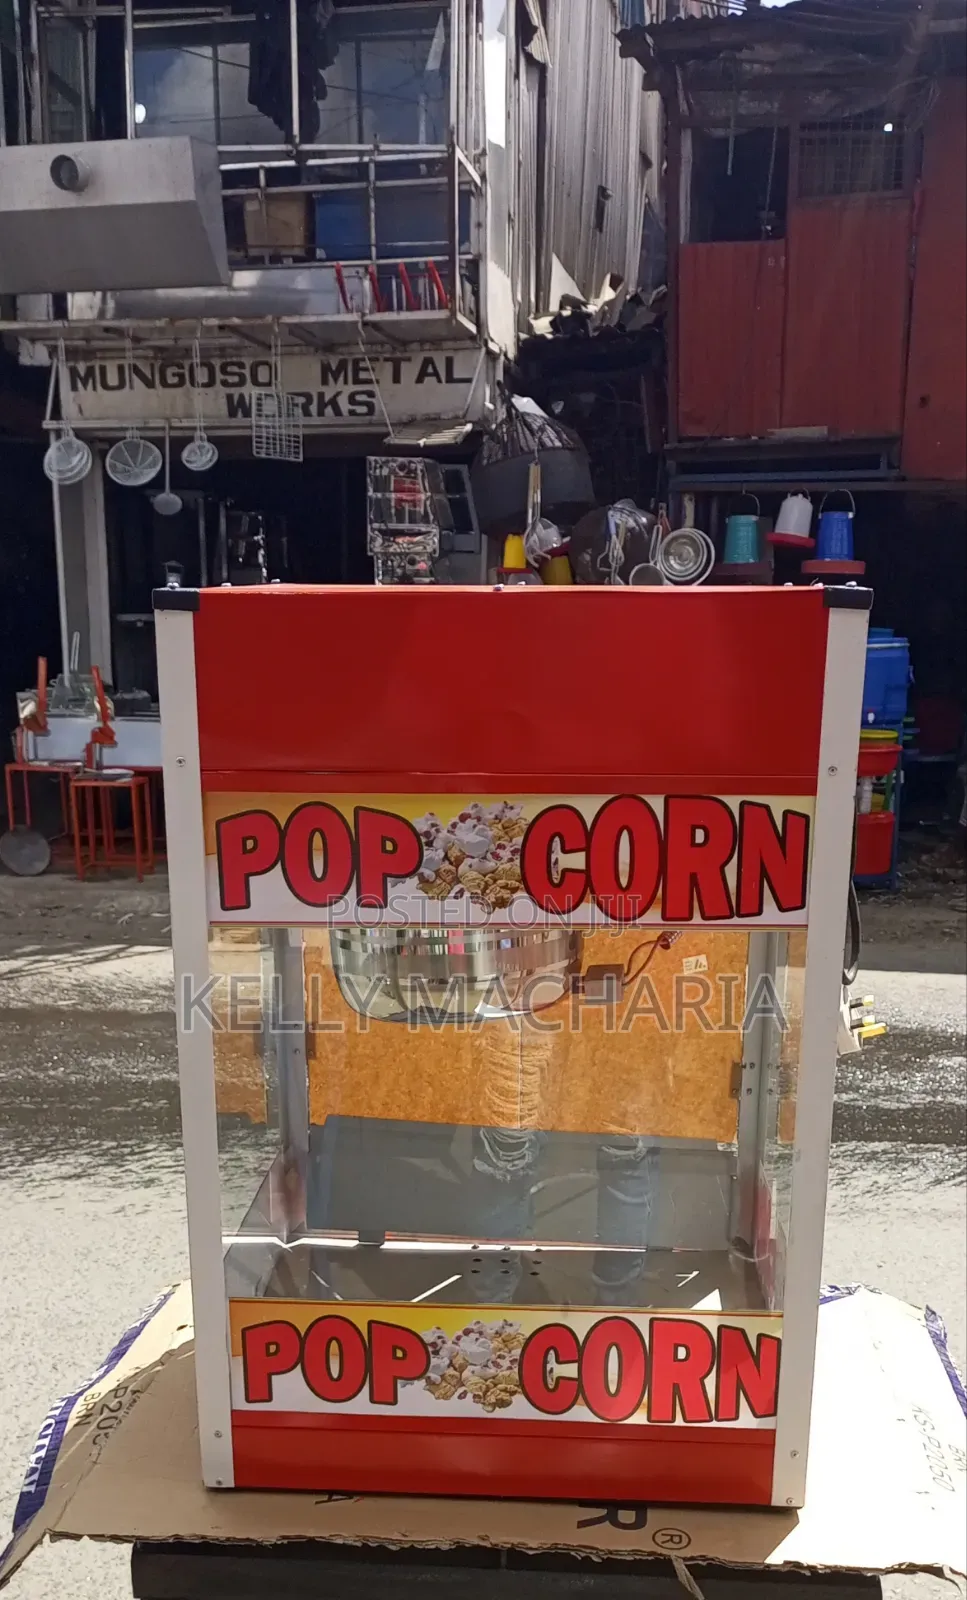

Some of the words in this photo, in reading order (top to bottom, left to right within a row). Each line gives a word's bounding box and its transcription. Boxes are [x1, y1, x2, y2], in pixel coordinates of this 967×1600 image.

[69, 360, 279, 391] MUNGOSO
[320, 356, 473, 386] METAL
[216, 801, 423, 911] POP
[521, 794, 810, 921] CORN
[242, 1316, 430, 1405] POP
[518, 1317, 782, 1423] CORN
